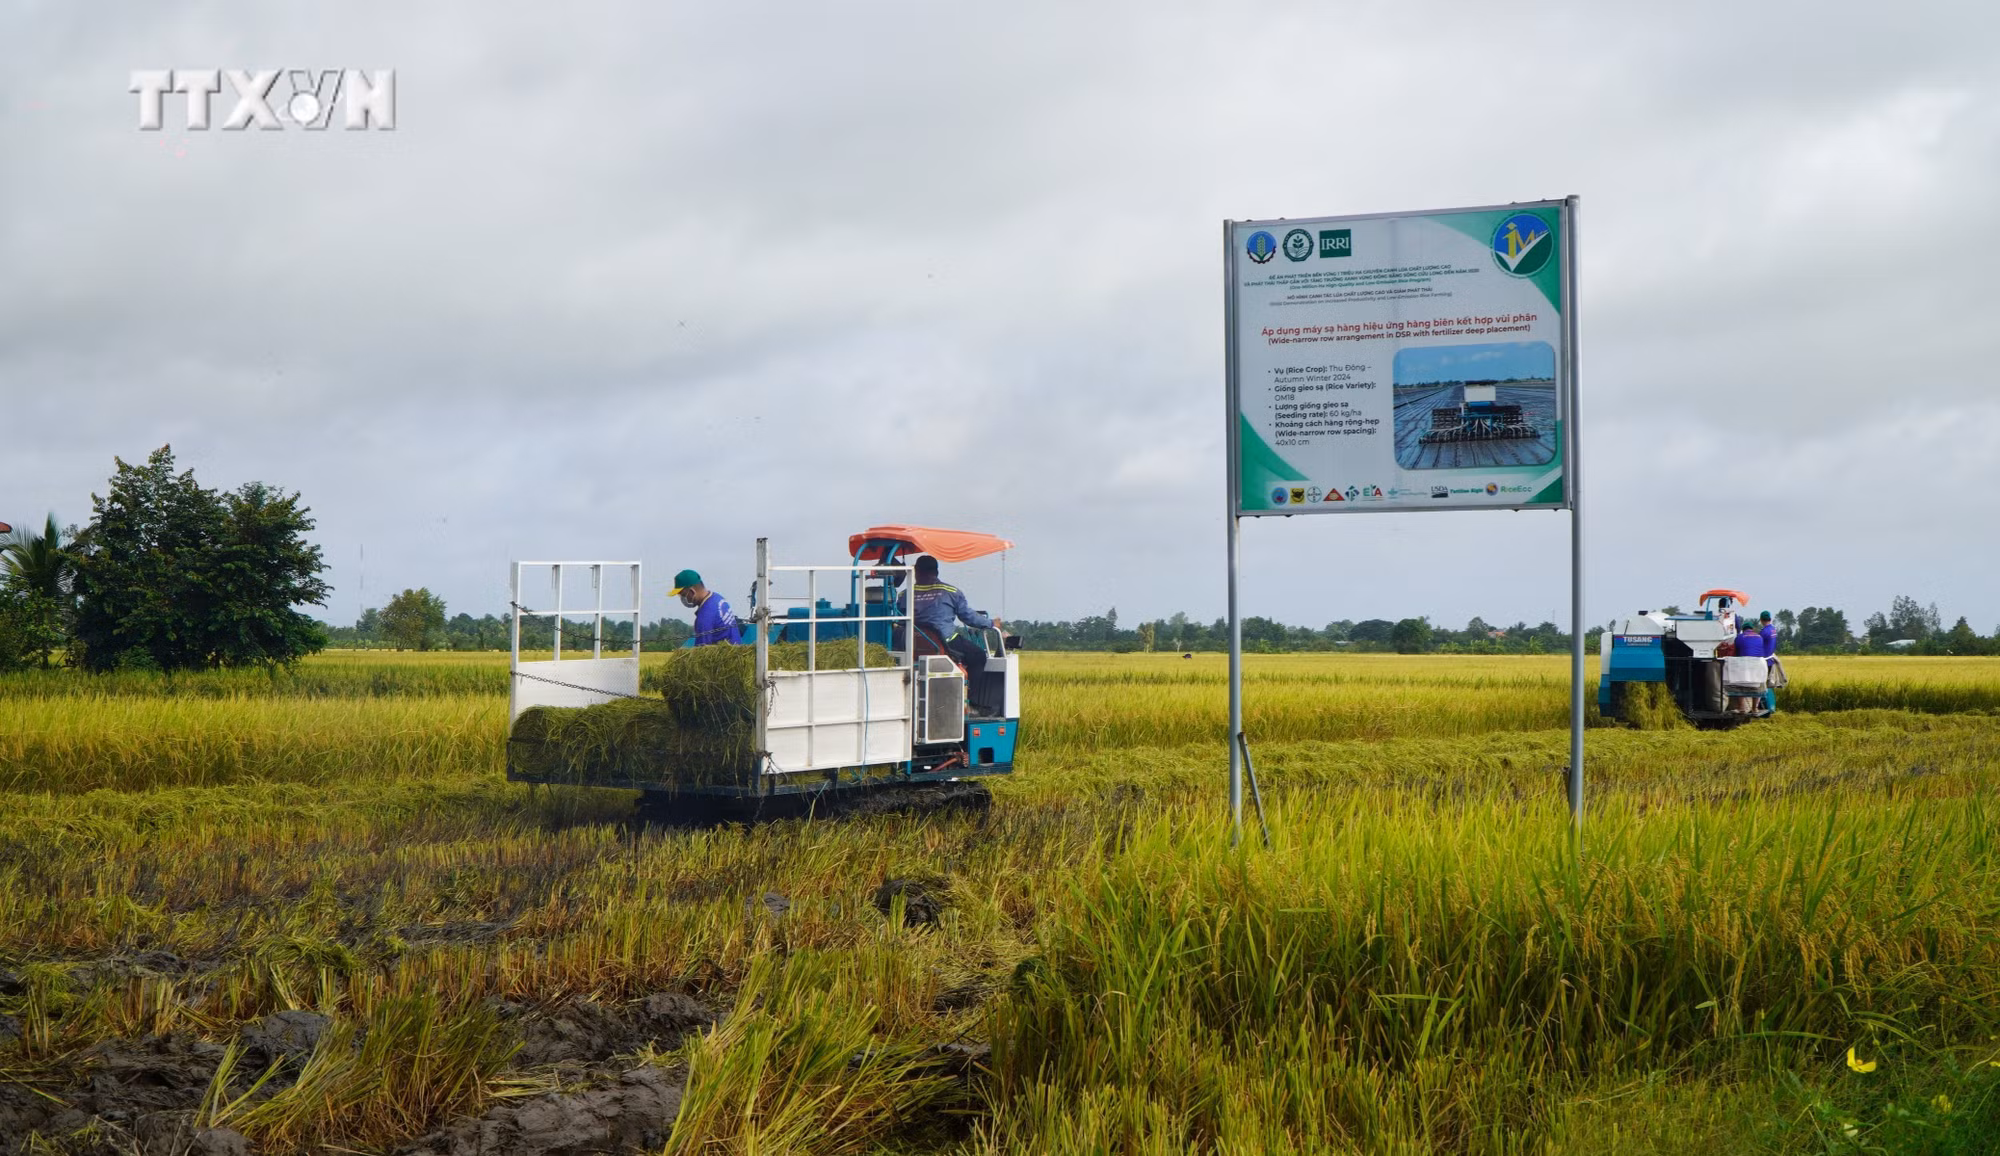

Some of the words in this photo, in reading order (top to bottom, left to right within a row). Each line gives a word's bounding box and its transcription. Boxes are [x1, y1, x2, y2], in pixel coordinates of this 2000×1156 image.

[1321, 237, 1350, 250] IRRI
[1262, 326, 1275, 337] Áp
[1277, 327, 1301, 336] dụng
[1303, 325, 1322, 335] máy
[1325, 326, 1335, 334] sạ
[1337, 323, 1361, 333] hàng
[1363, 322, 1383, 332] hiệu
[1386, 320, 1404, 330] ứng
[1407, 320, 1431, 329] hàng
[1434, 318, 1454, 328] biên
[1457, 315, 1472, 325] kết
[1475, 316, 1494, 325] hợp
[1495, 314, 1510, 323] vùi
[1512, 313, 1537, 324] phân
[1268, 336, 1319, 346] (Wide-narrow
[1336, 333, 1385, 342] arrangement
[1432, 328, 1464, 336] fertilizer
[1466, 327, 1485, 335] deep
[1487, 324, 1531, 334] placement)
[1286, 367, 1304, 375] (Rice
[1306, 366, 1328, 374] Crop):
[1345, 364, 1366, 372] Đông
[1274, 375, 1305, 383] Autumn
[1306, 374, 1331, 382] Winter
[1274, 385, 1296, 393] Giống
[1298, 384, 1314, 392] gieo
[1326, 383, 1344, 391] (Rice
[1345, 382, 1376, 390] Variety):
[1274, 394, 1295, 402] OM18
[1300, 401, 1321, 410] giống
[1323, 401, 1339, 409] gieo
[1275, 412, 1307, 421] (Seeding
[1309, 411, 1328, 419] rate):
[1341, 409, 1362, 418] kg/ha
[1275, 421, 1304, 429] Khoảng
[1324, 419, 1344, 427] hàng
[1275, 429, 1326, 438] (Wide-narrow
[1343, 427, 1377, 436] spacing):
